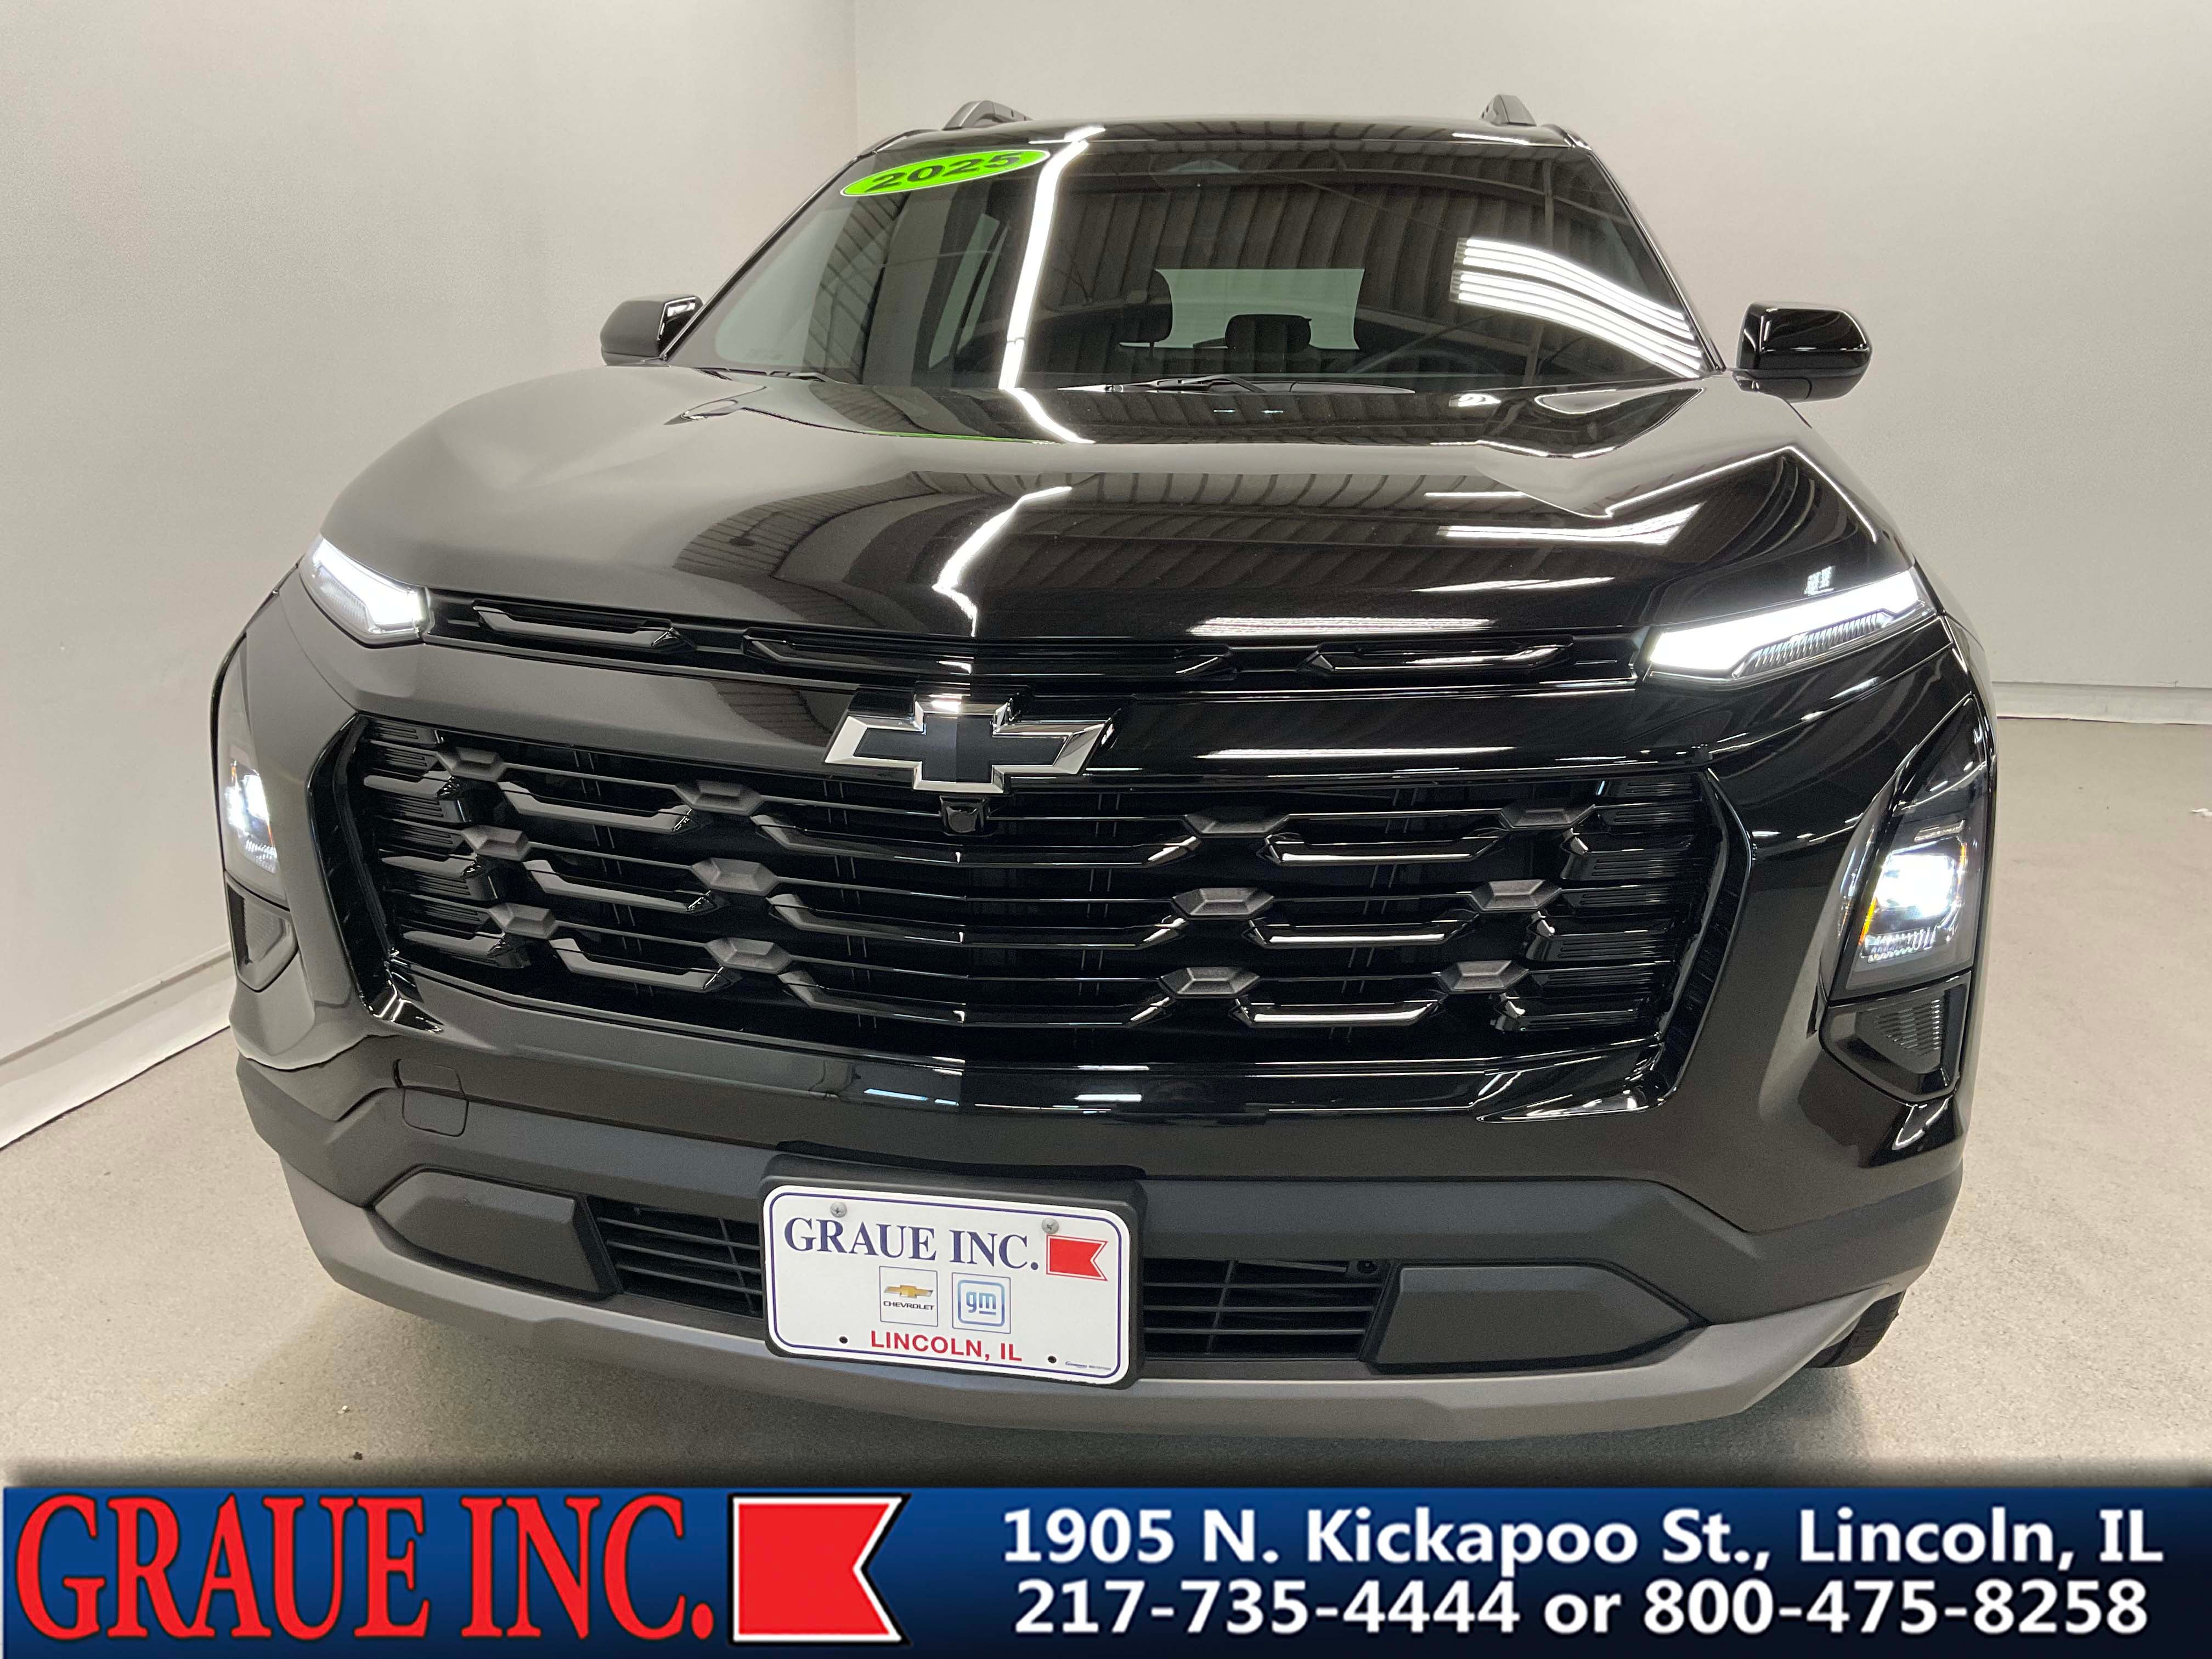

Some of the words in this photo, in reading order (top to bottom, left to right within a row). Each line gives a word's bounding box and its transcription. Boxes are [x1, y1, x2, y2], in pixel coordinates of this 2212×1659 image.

[864, 151, 1024, 193] 2025
[784, 1217, 936, 1261] GRAUE
[949, 1229, 1039, 1271] INC.
[883, 1301, 935, 1310] CHEVROLET
[966, 1291, 997, 1316] gm
[871, 1330, 991, 1362] LINCOLN,
[1000, 1342, 1023, 1362] IL
